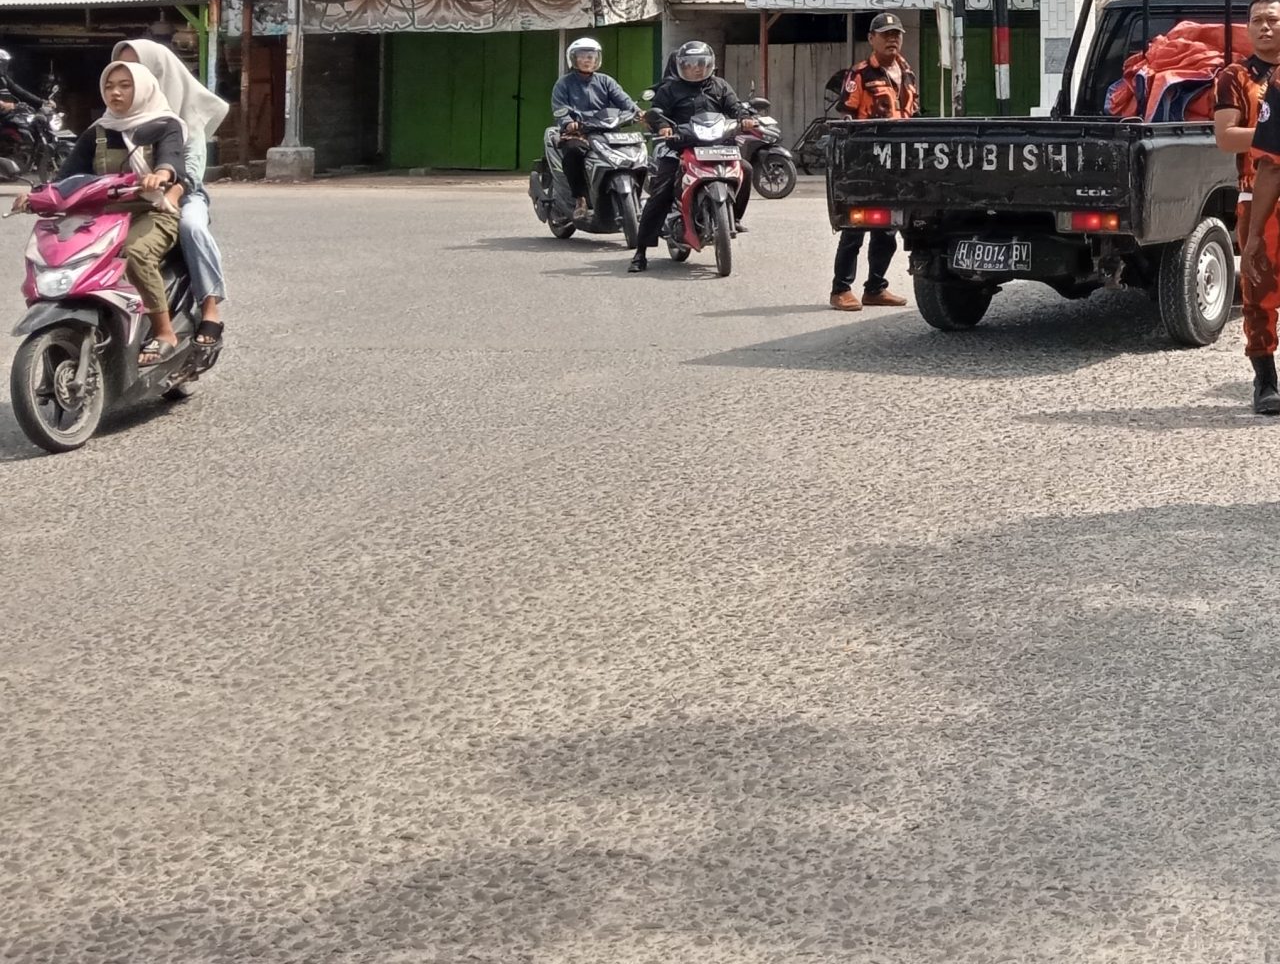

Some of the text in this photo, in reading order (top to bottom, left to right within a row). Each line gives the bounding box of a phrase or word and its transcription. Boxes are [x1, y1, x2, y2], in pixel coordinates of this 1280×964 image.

[873, 142, 1084, 173] MITSUBISHI
[958, 243, 1027, 262] H 8014 BV
